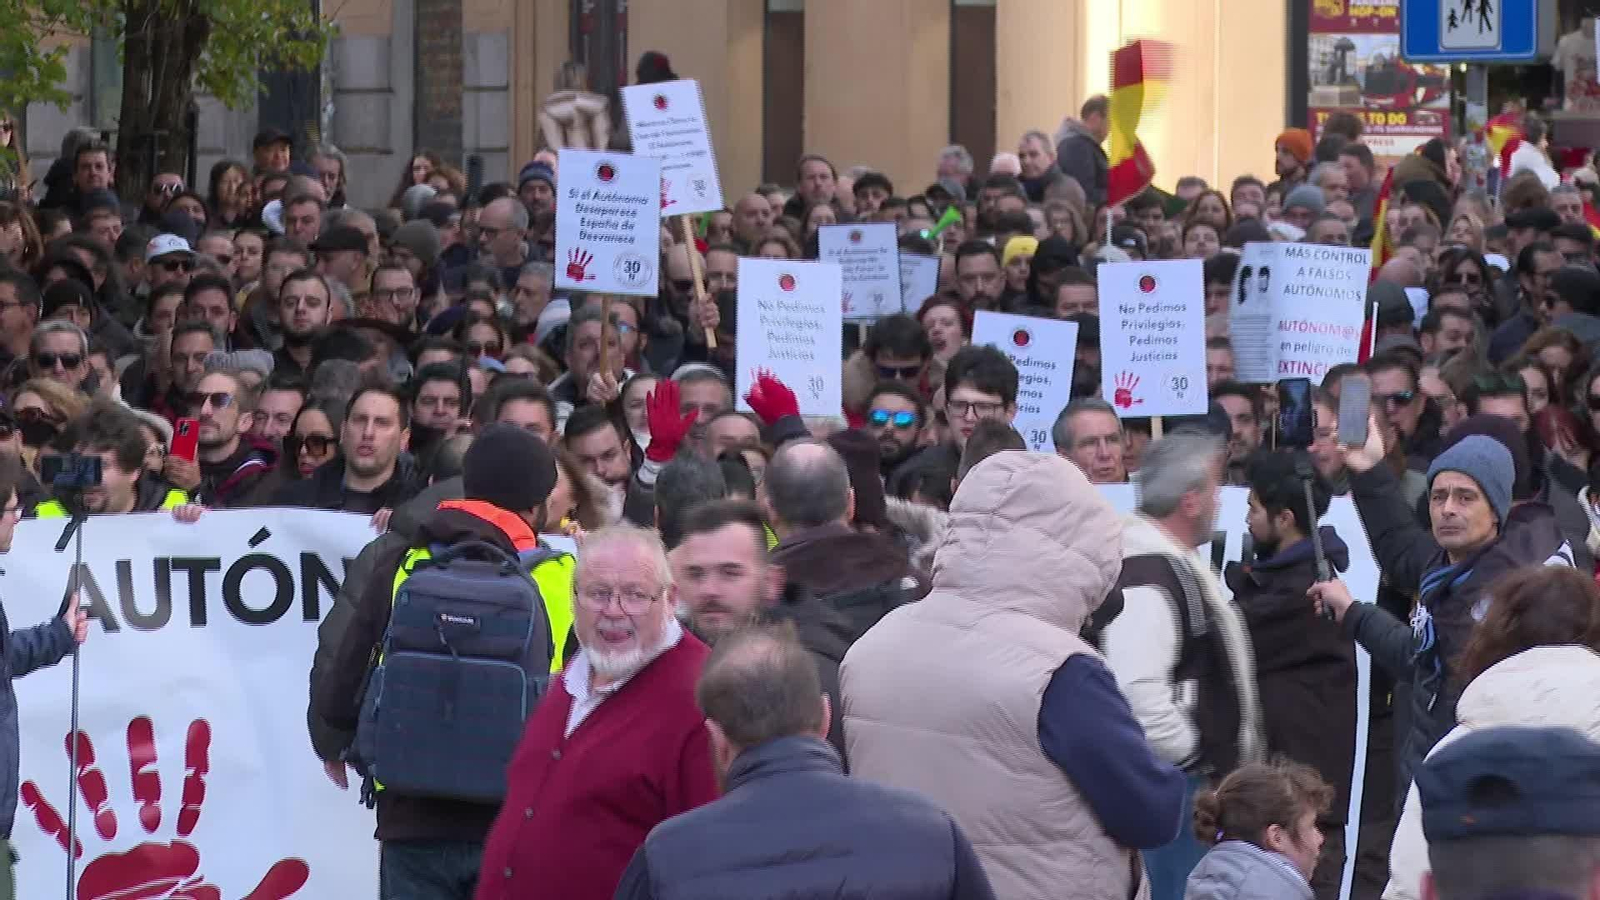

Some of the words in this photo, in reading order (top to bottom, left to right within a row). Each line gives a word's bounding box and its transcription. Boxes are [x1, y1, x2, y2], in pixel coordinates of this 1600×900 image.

[1387, 111, 1407, 125] DO
[1284, 247, 1310, 258] MÁS
[1313, 249, 1368, 265] CONTROL
[623, 260, 641, 274] 30
[1297, 266, 1305, 276] A
[1309, 267, 1351, 280] FALSOS
[1283, 283, 1362, 301] AUTÓNOMOS
[1119, 304, 1135, 314] No
[1138, 302, 1187, 313] Pedimos
[1129, 335, 1178, 347] Pedimos
[1280, 342, 1292, 352] en
[1294, 340, 1334, 355] peligro
[1130, 350, 1178, 362] Justicias
[1171, 376, 1188, 391] 30
[1030, 429, 1047, 444] 30
[57, 525, 357, 634] AUTÓN
